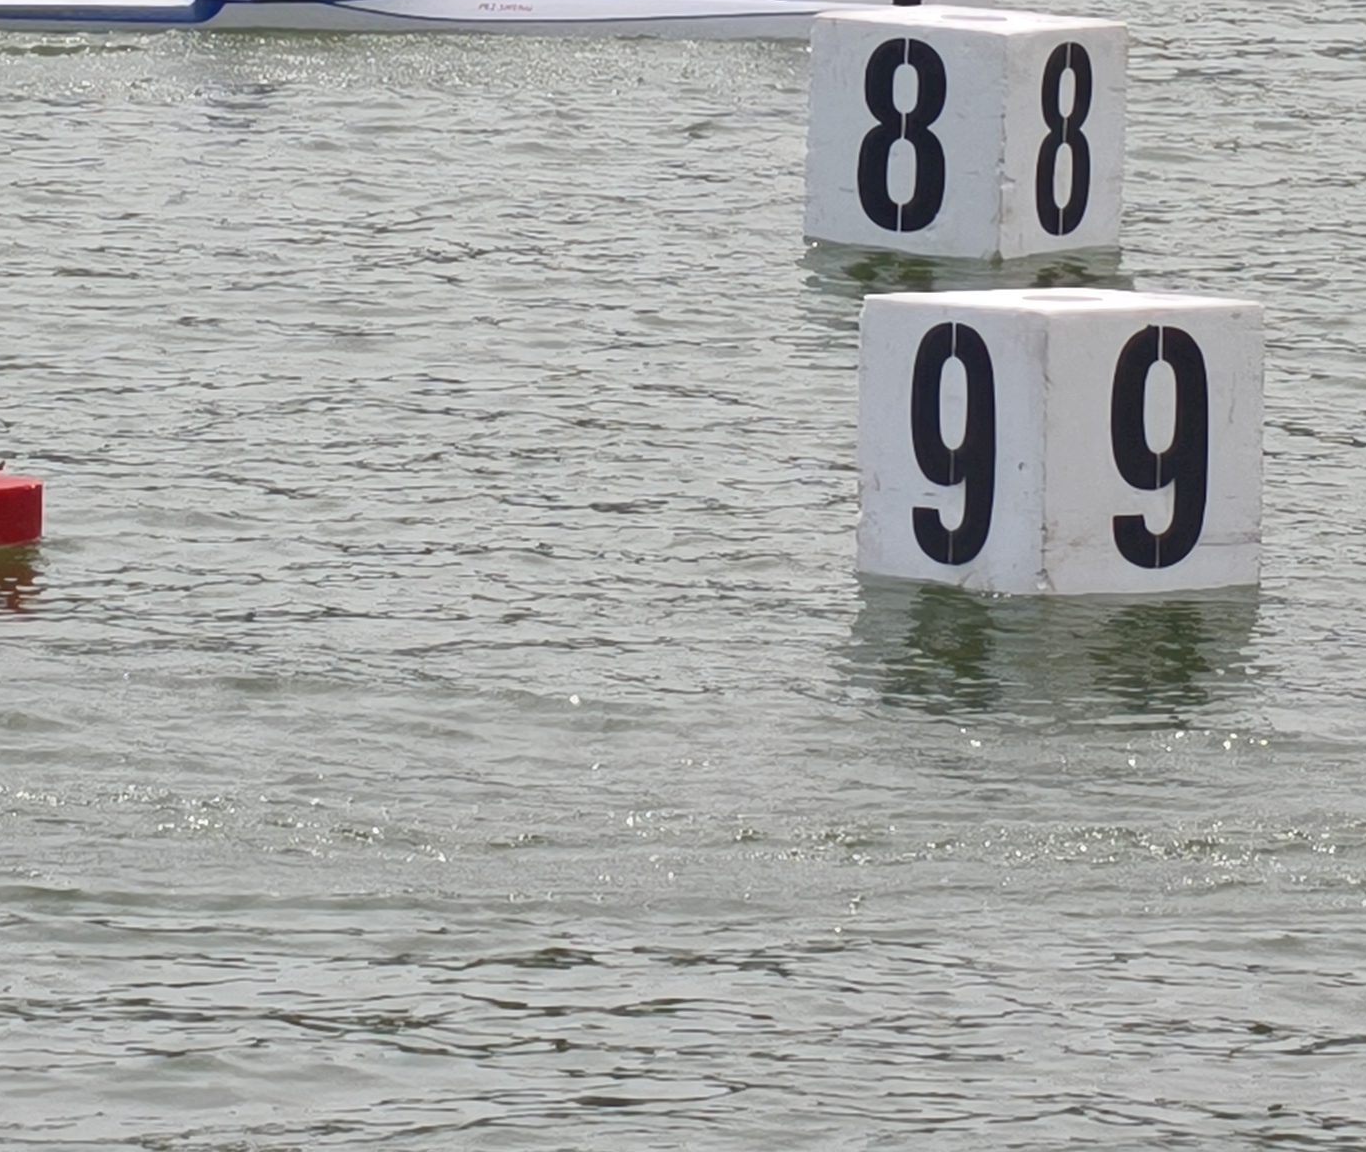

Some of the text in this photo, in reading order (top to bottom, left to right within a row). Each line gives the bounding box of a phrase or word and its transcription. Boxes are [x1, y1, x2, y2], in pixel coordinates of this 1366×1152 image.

[857, 38, 947, 232] 8
[1036, 42, 1093, 236] 8
[911, 322, 996, 565] 9
[1110, 325, 1209, 569] 9
